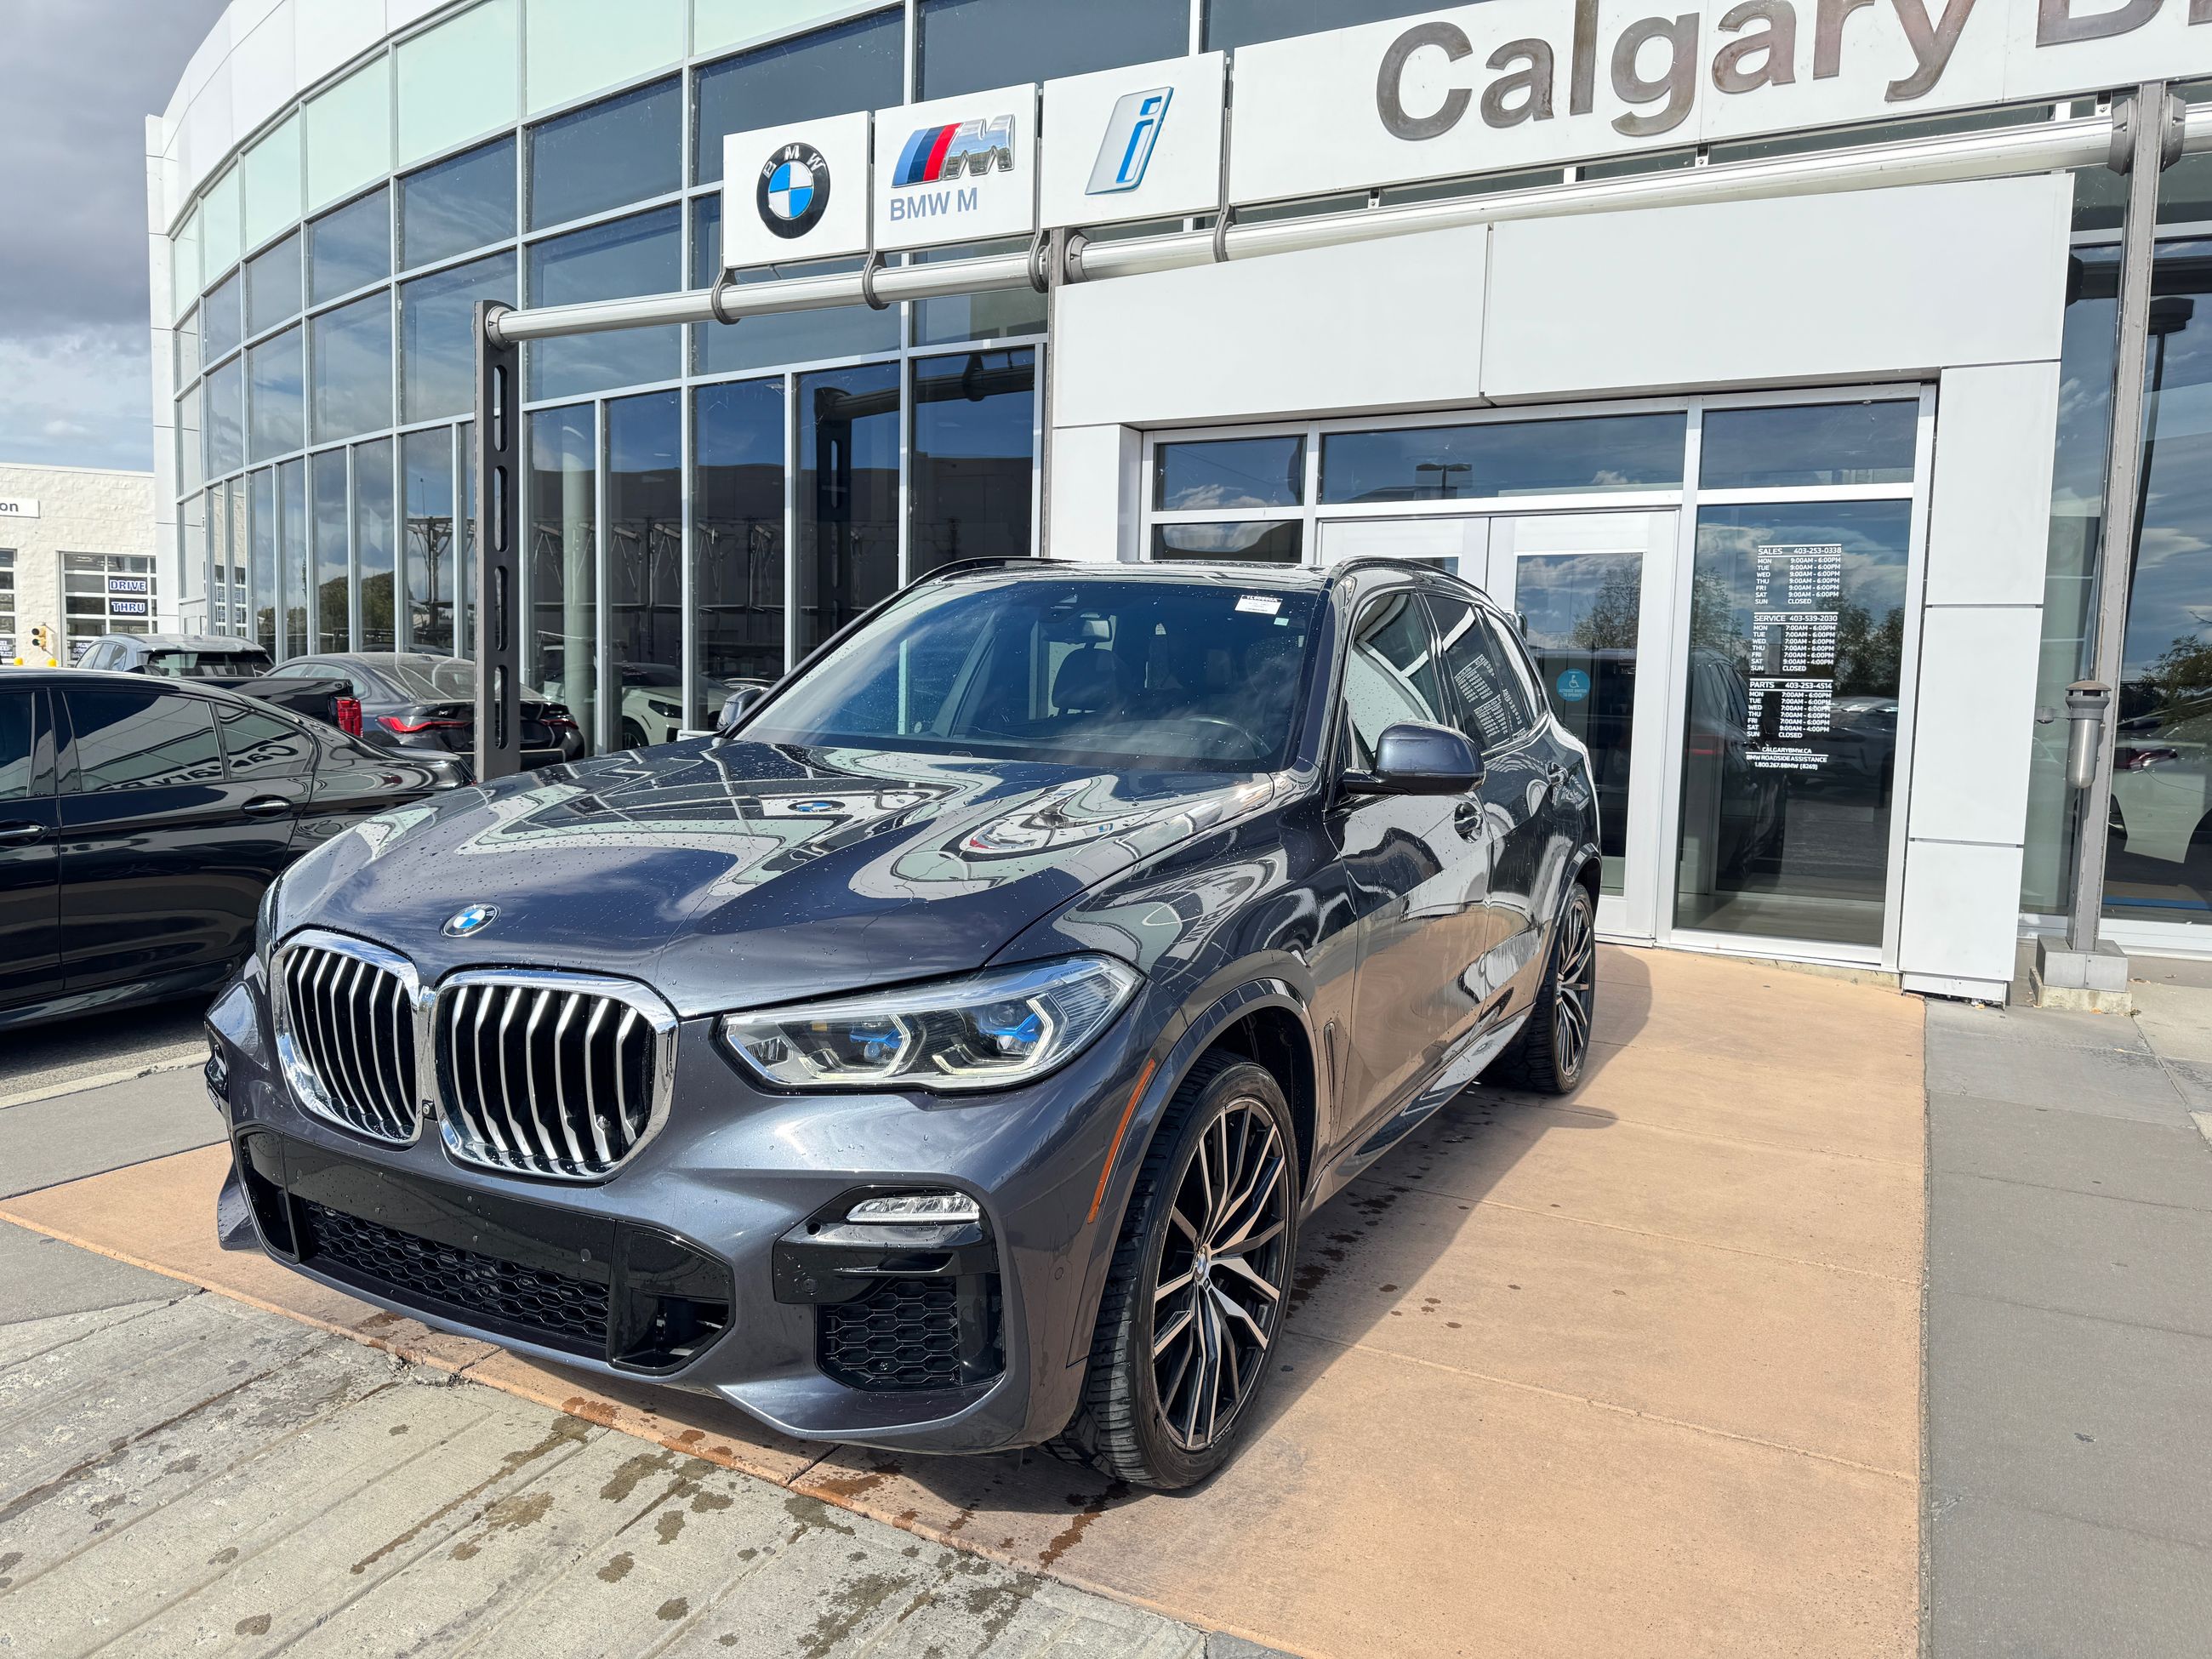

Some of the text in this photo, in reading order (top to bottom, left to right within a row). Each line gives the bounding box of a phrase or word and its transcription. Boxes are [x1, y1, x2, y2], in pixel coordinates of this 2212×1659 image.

[1376, 0, 1970, 142] Calgary
[761, 145, 827, 180] BMW
[890, 187, 978, 222] BMW M
[110, 579, 146, 592] DRIVE
[111, 601, 145, 613] THRU
